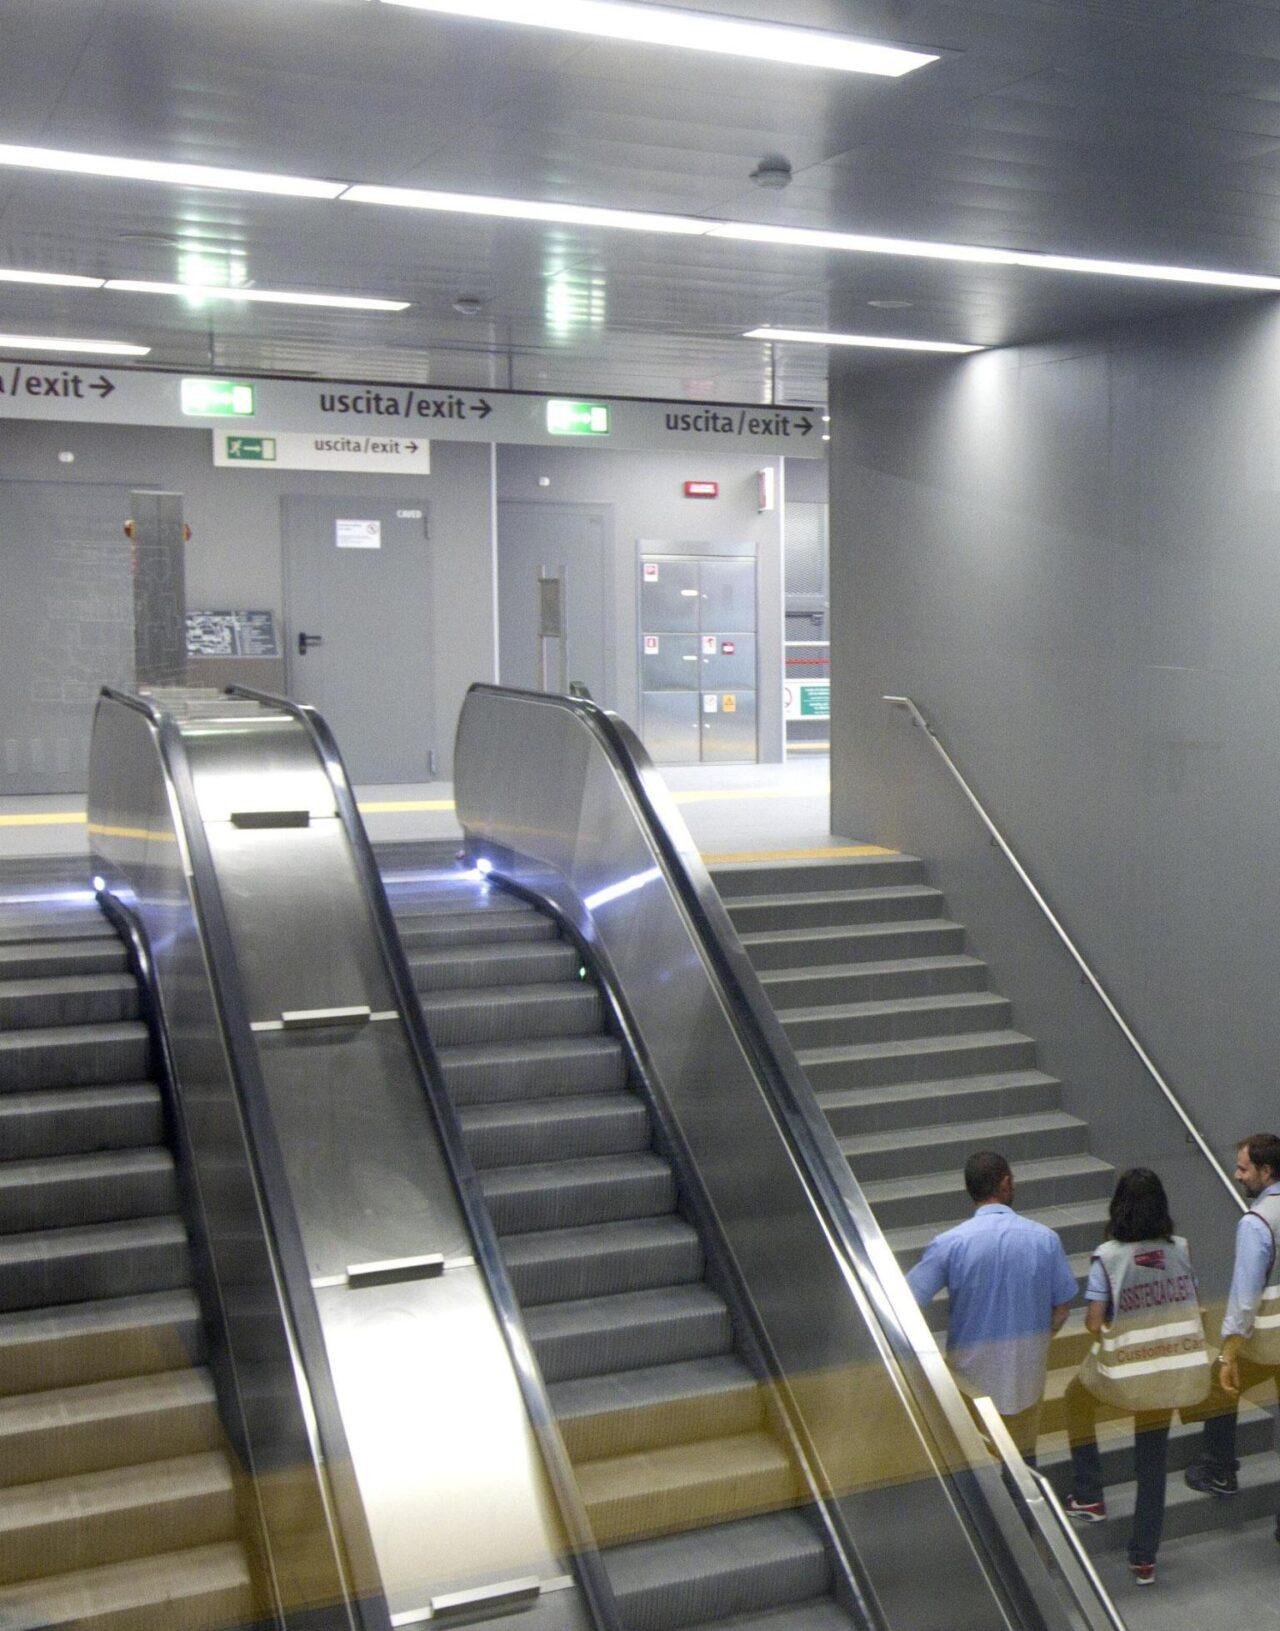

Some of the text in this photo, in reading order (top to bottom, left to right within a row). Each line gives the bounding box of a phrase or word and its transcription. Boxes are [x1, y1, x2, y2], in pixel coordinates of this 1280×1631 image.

[320, 390, 466, 420] uscita/exit
[665, 410, 791, 436] uscita/exit
[1116, 1341, 1180, 1363] Customer
